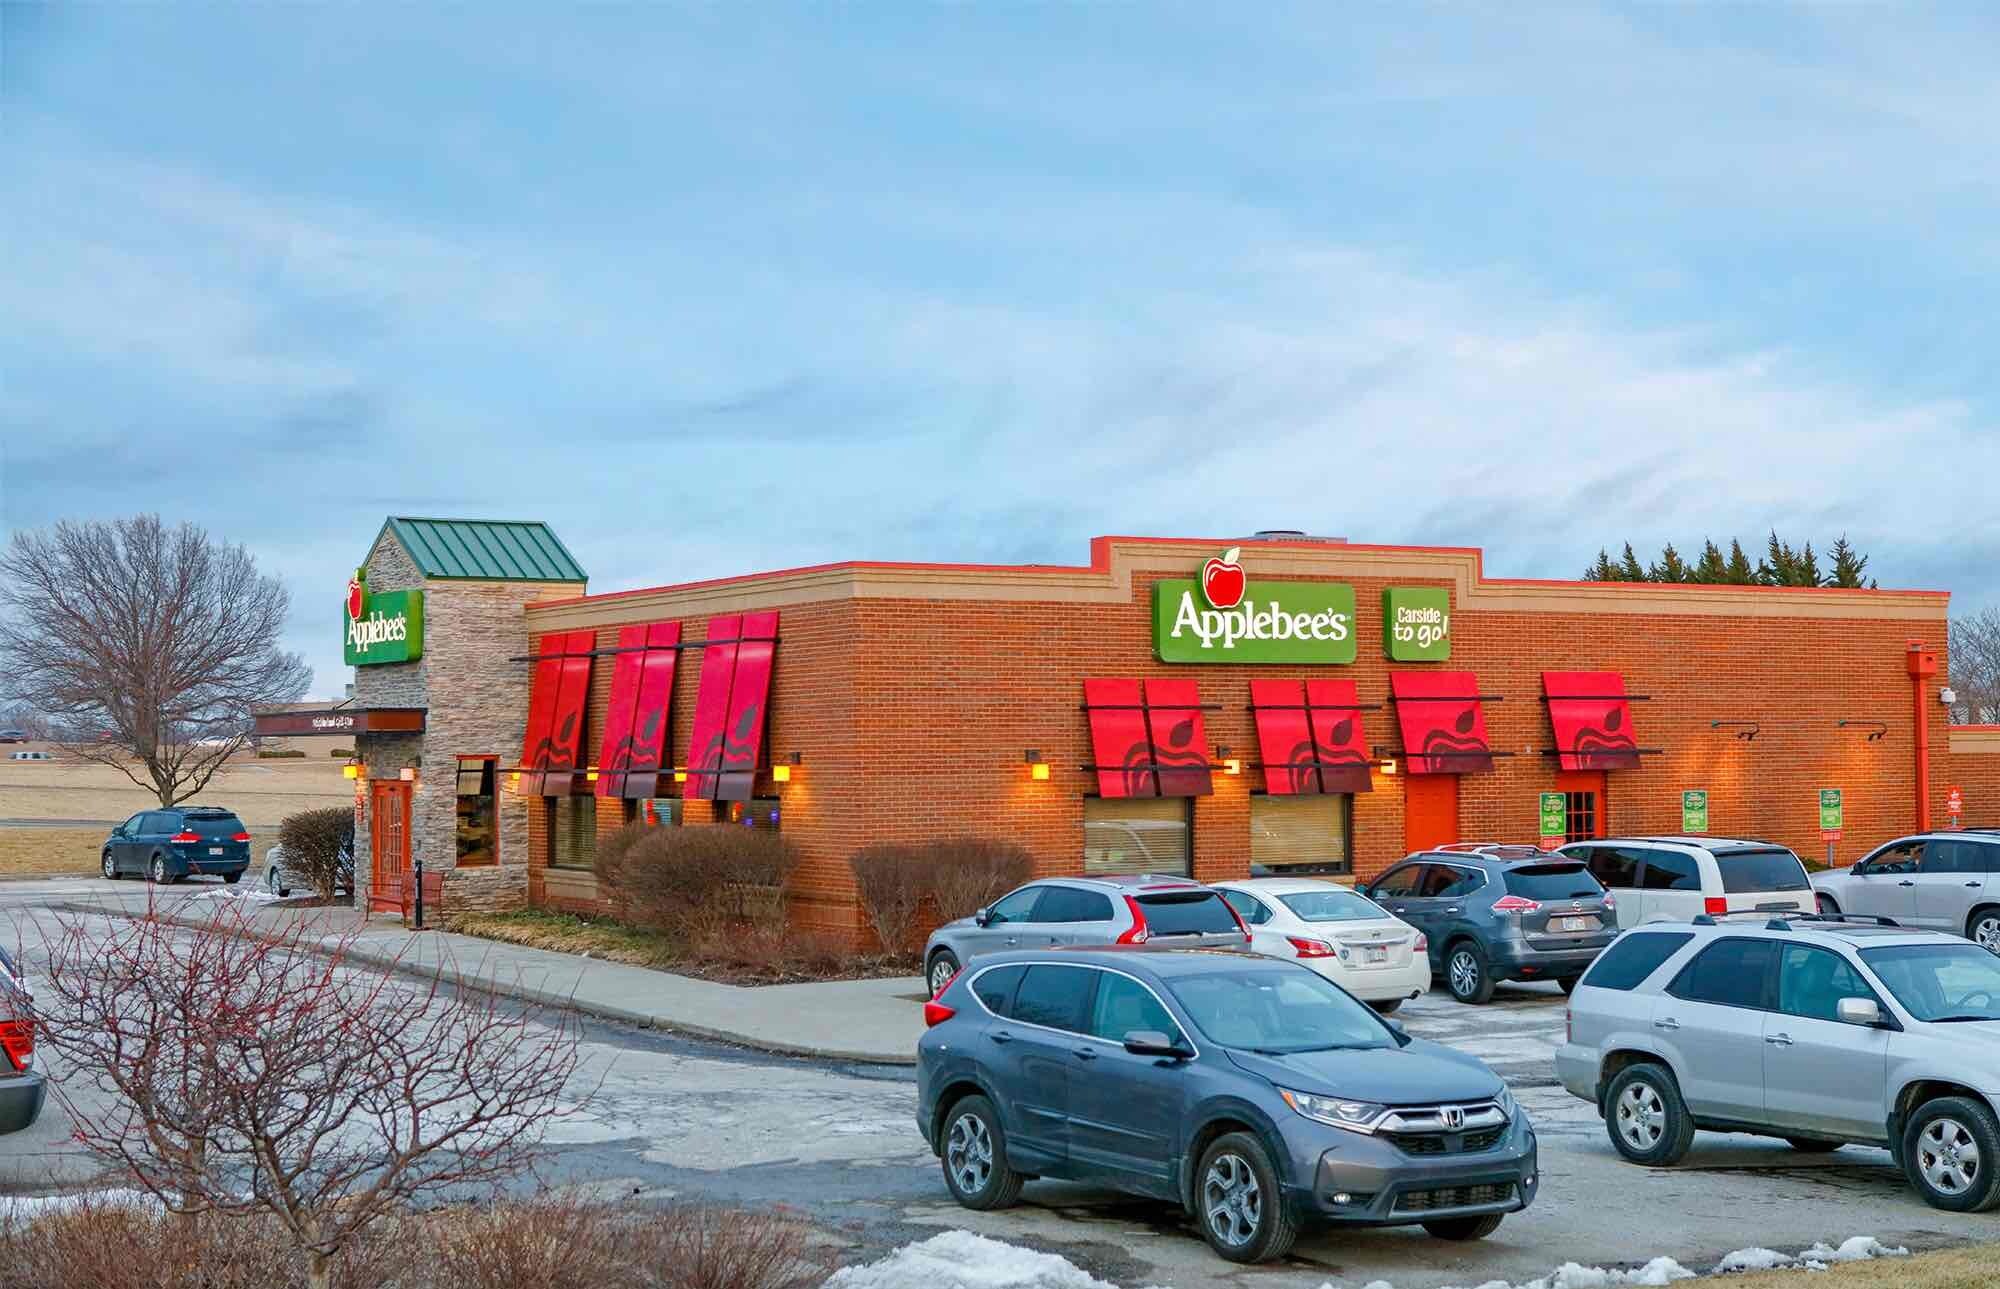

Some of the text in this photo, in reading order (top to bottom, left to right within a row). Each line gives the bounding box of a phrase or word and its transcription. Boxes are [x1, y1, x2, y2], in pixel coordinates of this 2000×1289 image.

[346, 610, 407, 653] Applebee's
[1170, 590, 1349, 649] Applebee's
[1392, 615, 1449, 649] to go!
[1397, 606, 1441, 624] Carside
